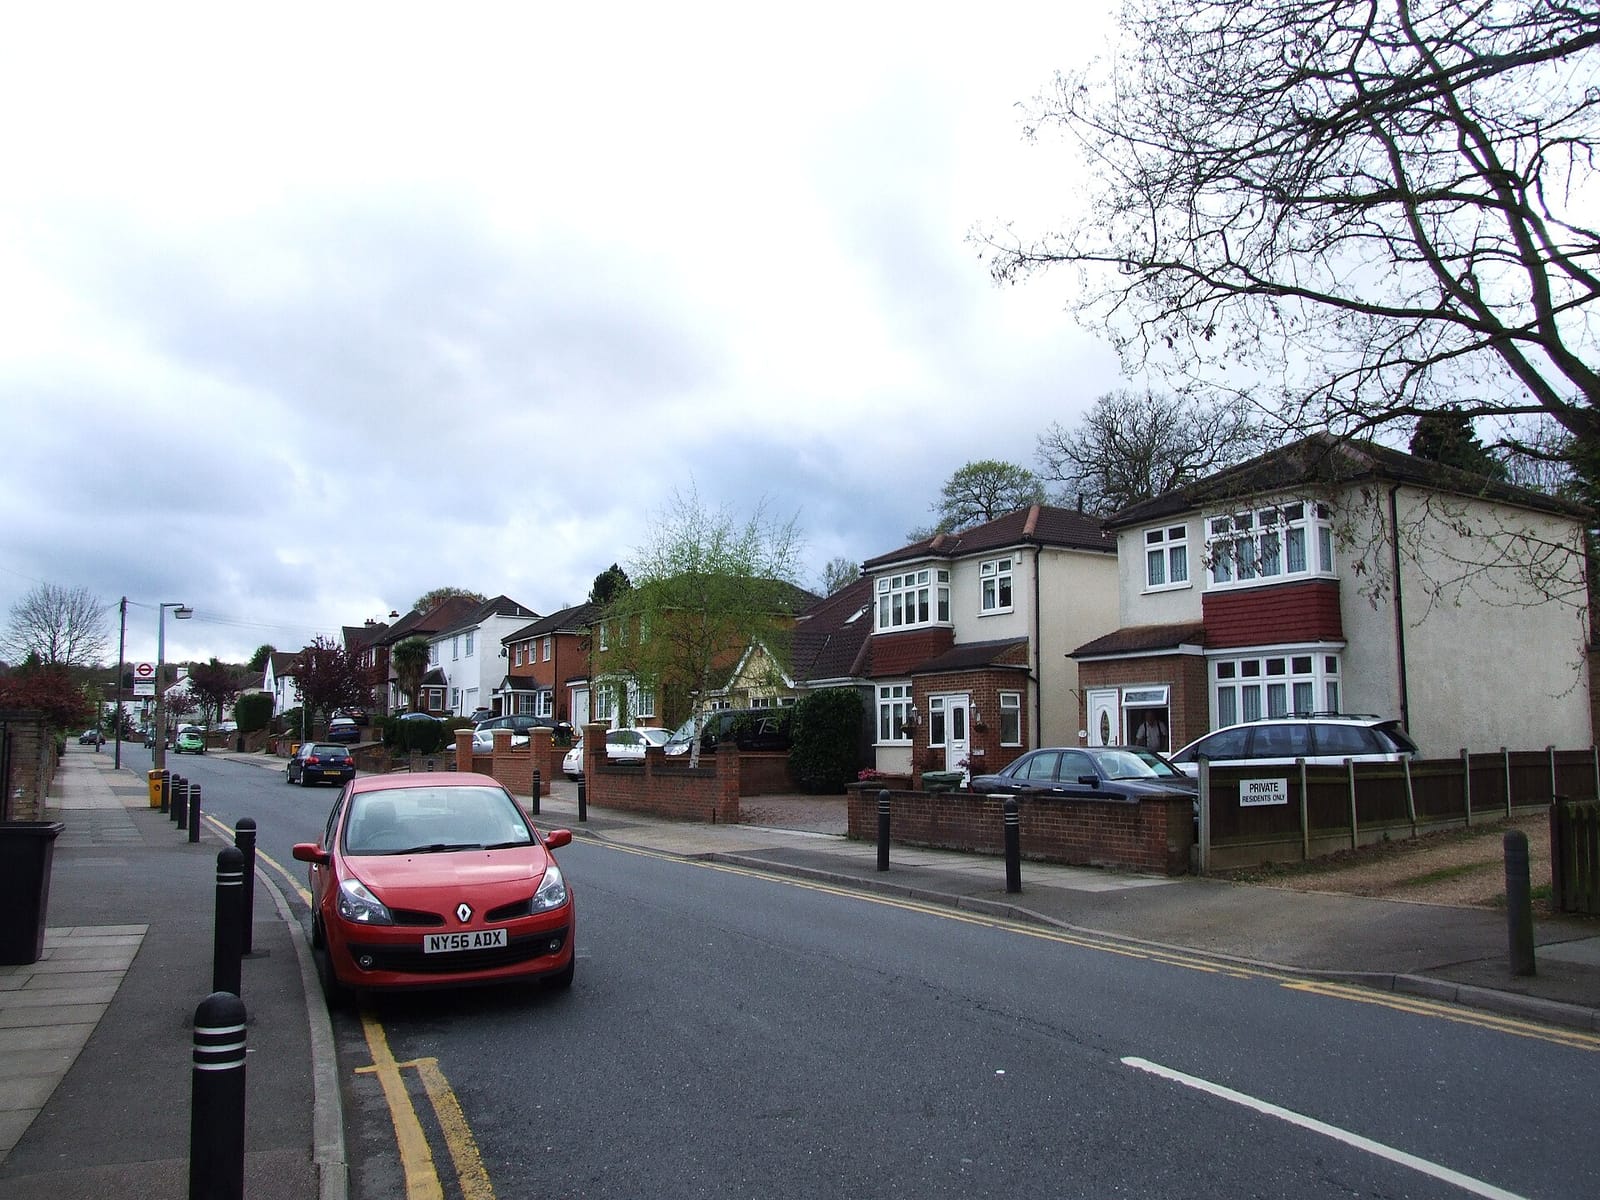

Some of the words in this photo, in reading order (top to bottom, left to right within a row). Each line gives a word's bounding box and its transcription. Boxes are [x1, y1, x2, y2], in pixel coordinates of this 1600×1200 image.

[1250, 782, 1279, 793] PRIVATE
[430, 935, 469, 950] NY56
[474, 931, 502, 948] ADX
